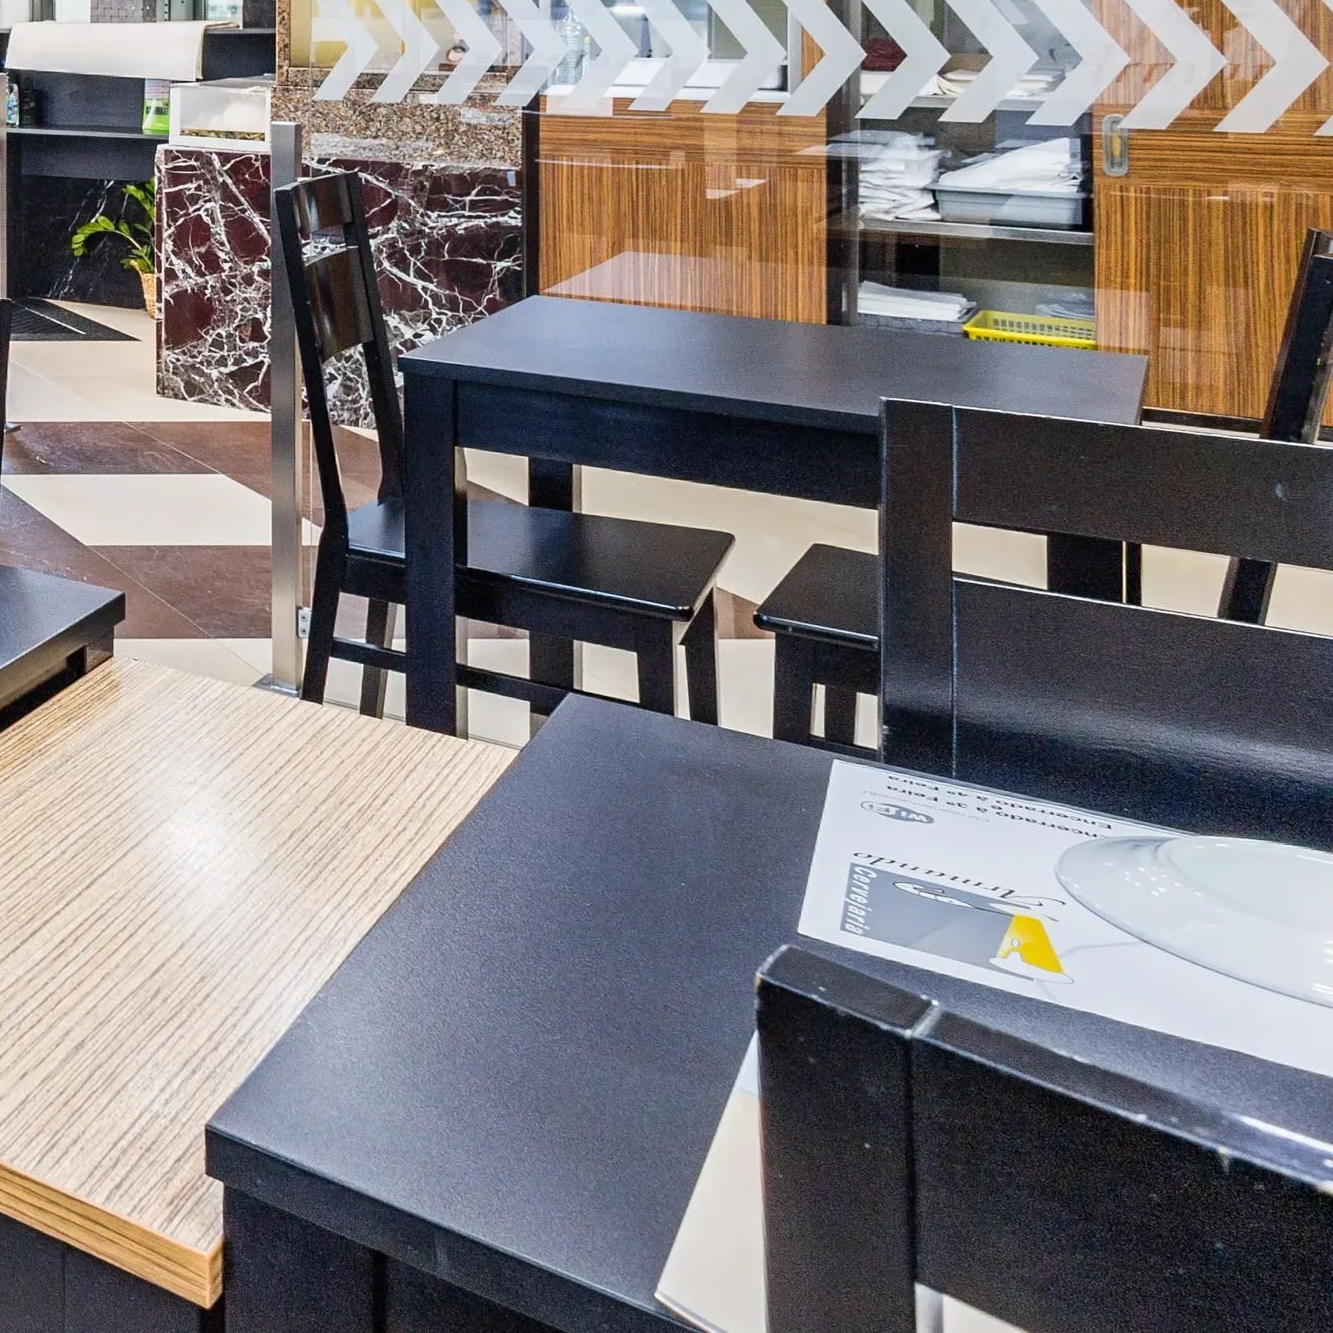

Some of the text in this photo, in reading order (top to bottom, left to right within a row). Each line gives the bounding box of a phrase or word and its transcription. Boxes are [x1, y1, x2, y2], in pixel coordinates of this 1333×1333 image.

[886, 785, 939, 802] Feira
[887, 775, 940, 791] Feira
[995, 800, 1112, 829] Encerrado
[995, 811, 1110, 839] ncerrado
[844, 866, 878, 935] Cervejaria
[852, 851, 1067, 923] Armando
